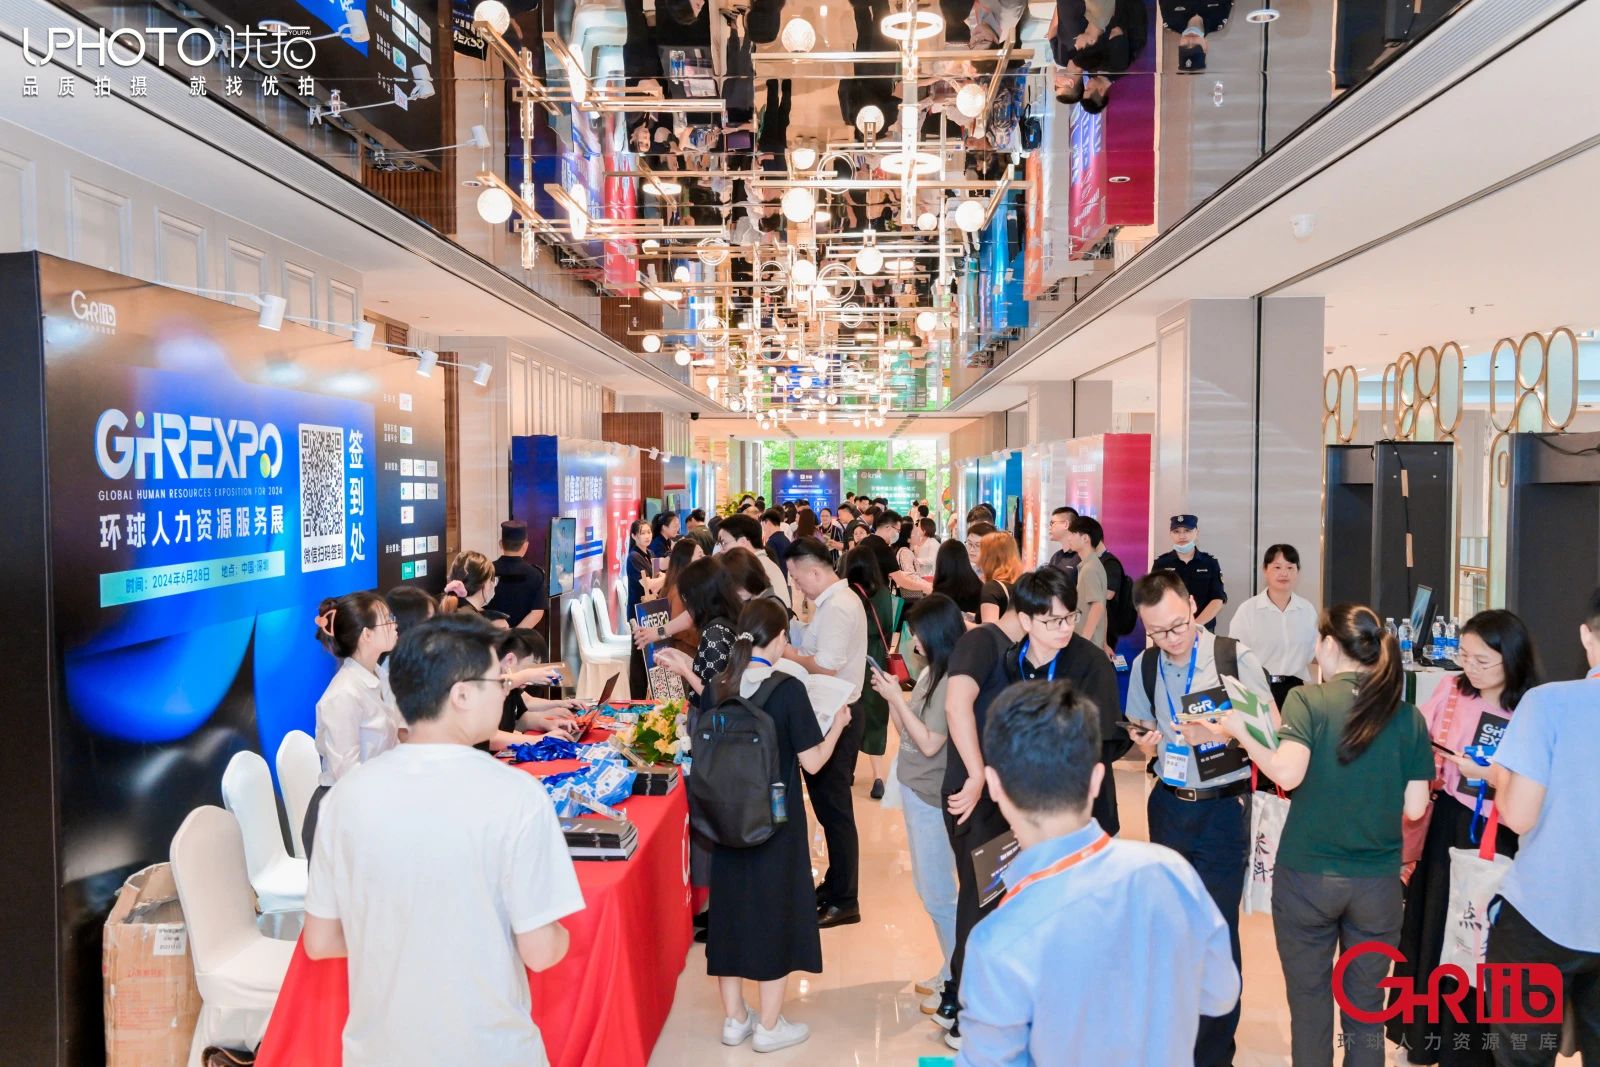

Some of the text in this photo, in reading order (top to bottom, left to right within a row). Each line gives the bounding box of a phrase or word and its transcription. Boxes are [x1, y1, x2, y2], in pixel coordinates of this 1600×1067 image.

[98, 486, 283, 501] GLOBAL HUMAN RESOURCES EXPOSITION FOR 2024
[349, 429, 366, 564] 签到处
[99, 505, 285, 551] 环球人力资源服务展
[304, 544, 344, 565] 微信扫码签到
[1482, 723, 1506, 738] GH
